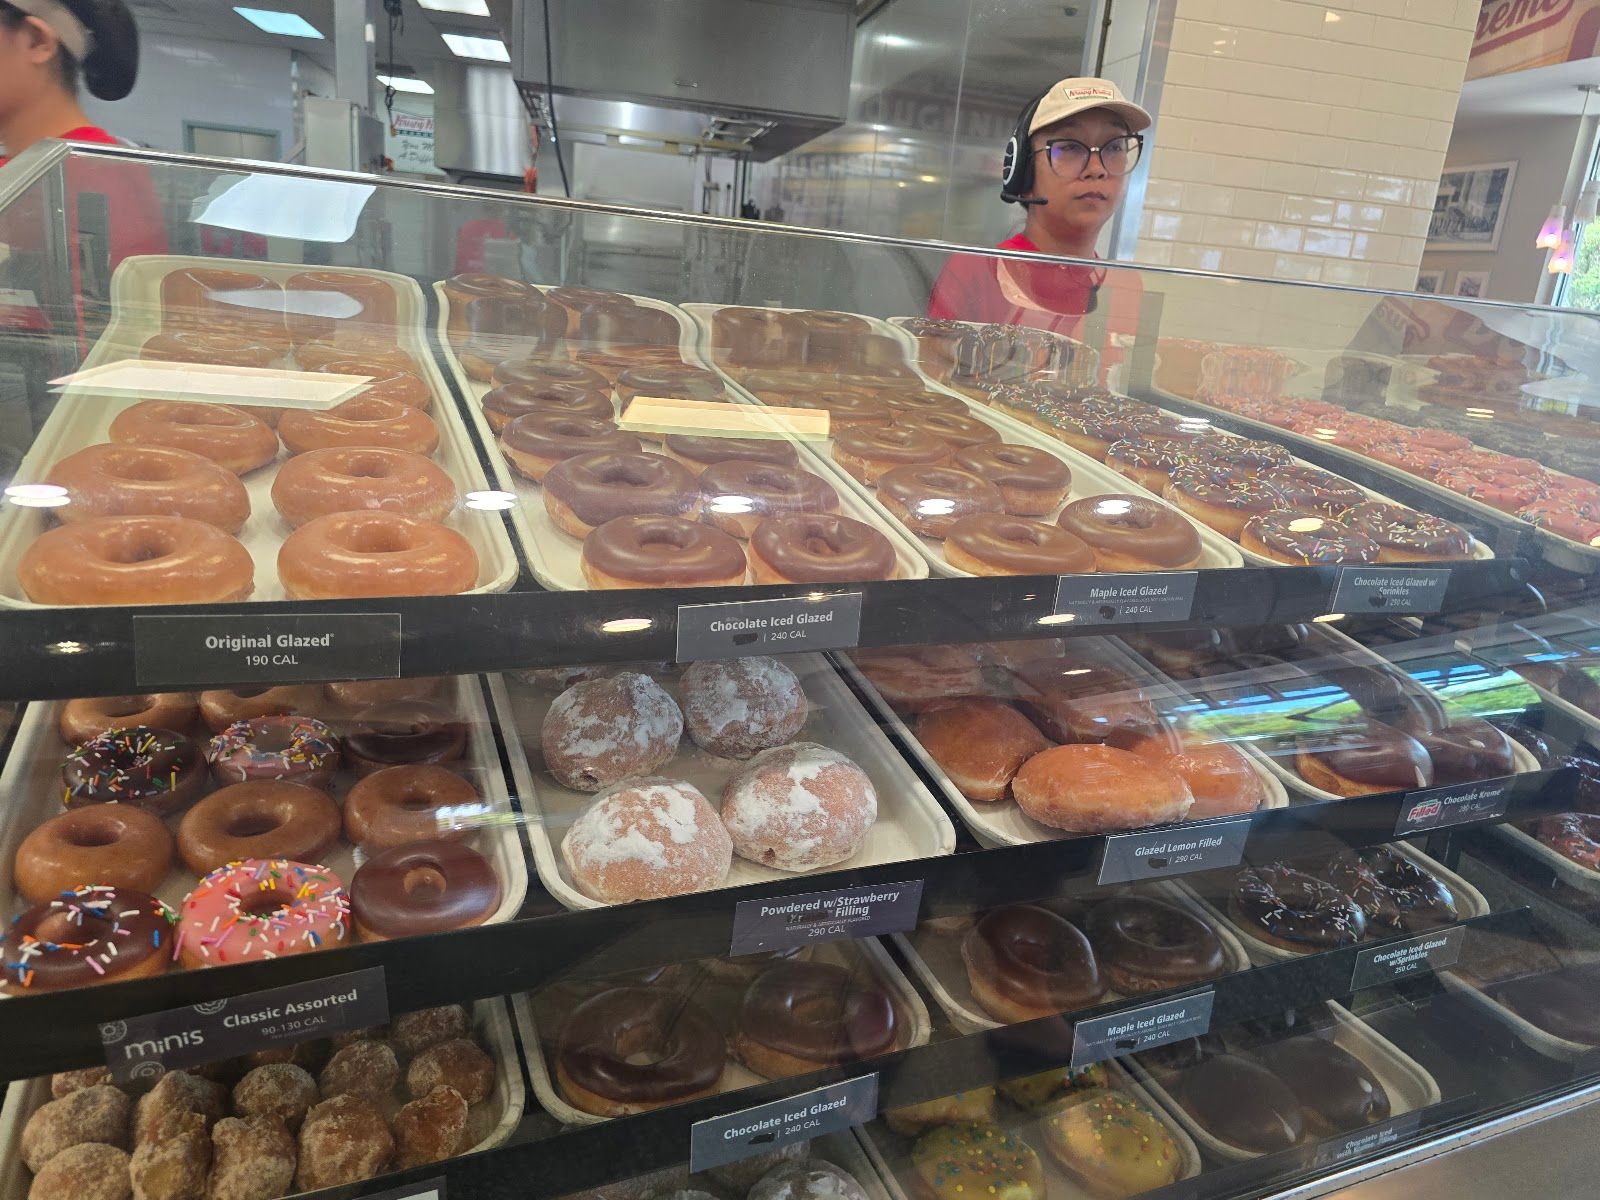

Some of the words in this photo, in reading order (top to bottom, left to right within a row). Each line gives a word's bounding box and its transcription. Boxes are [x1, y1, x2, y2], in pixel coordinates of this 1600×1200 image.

[1354, 577, 1389, 587] Chocolate
[1389, 577, 1405, 587] Iced
[1405, 577, 1428, 587] Glazed
[1090, 587, 1118, 599] Maple
[1119, 586, 1138, 597] Iced
[1139, 585, 1168, 596] Glazed
[1379, 587, 1409, 596] Sprinkles
[1124, 606, 1138, 614] 240
[1139, 605, 1153, 613] CAL
[710, 618, 768, 633] Chocolate
[770, 614, 793, 627] Iced
[796, 611, 834, 625] Glazed
[205, 634, 271, 651] Original
[770, 631, 788, 642] 240
[789, 630, 807, 639] CAL
[245, 655, 269, 666] 190
[272, 654, 299, 666] CAL
[1443, 793, 1478, 805] Chocolate
[1408, 803, 1439, 819] Filled
[1135, 844, 1166, 857] Glazed
[1167, 840, 1197, 853] Lemon
[1198, 836, 1223, 848] Filled
[1174, 855, 1188, 863] 290
[1189, 853, 1203, 861] CAL
[760, 899, 820, 917] Powdered
[823, 891, 900, 909] w/Strawberry
[835, 905, 870, 918] Filling
[807, 927, 826, 938] 290
[827, 925, 846, 935] CAL
[1373, 948, 1407, 963] Chocolate
[1408, 942, 1424, 954] Iced
[1424, 937, 1447, 950] Glazed
[1406, 963, 1418, 971] CAL
[223, 1008, 281, 1029] Classic
[285, 989, 358, 1015] Assorted
[261, 1020, 301, 1036] 90-130
[303, 1015, 327, 1028] CAL
[1107, 1023, 1135, 1037] Maple
[1136, 1016, 1155, 1029] Iced
[1156, 1009, 1185, 1024] Glazed
[1143, 1033, 1156, 1043] 240
[1157, 1030, 1171, 1039] CAL
[124, 1029, 205, 1060] minis
[724, 1117, 781, 1140] Chocolate
[784, 1107, 807, 1123] Iced
[810, 1096, 847, 1115] Glazed
[784, 1124, 801, 1135] 240
[803, 1118, 821, 1129] CAL
